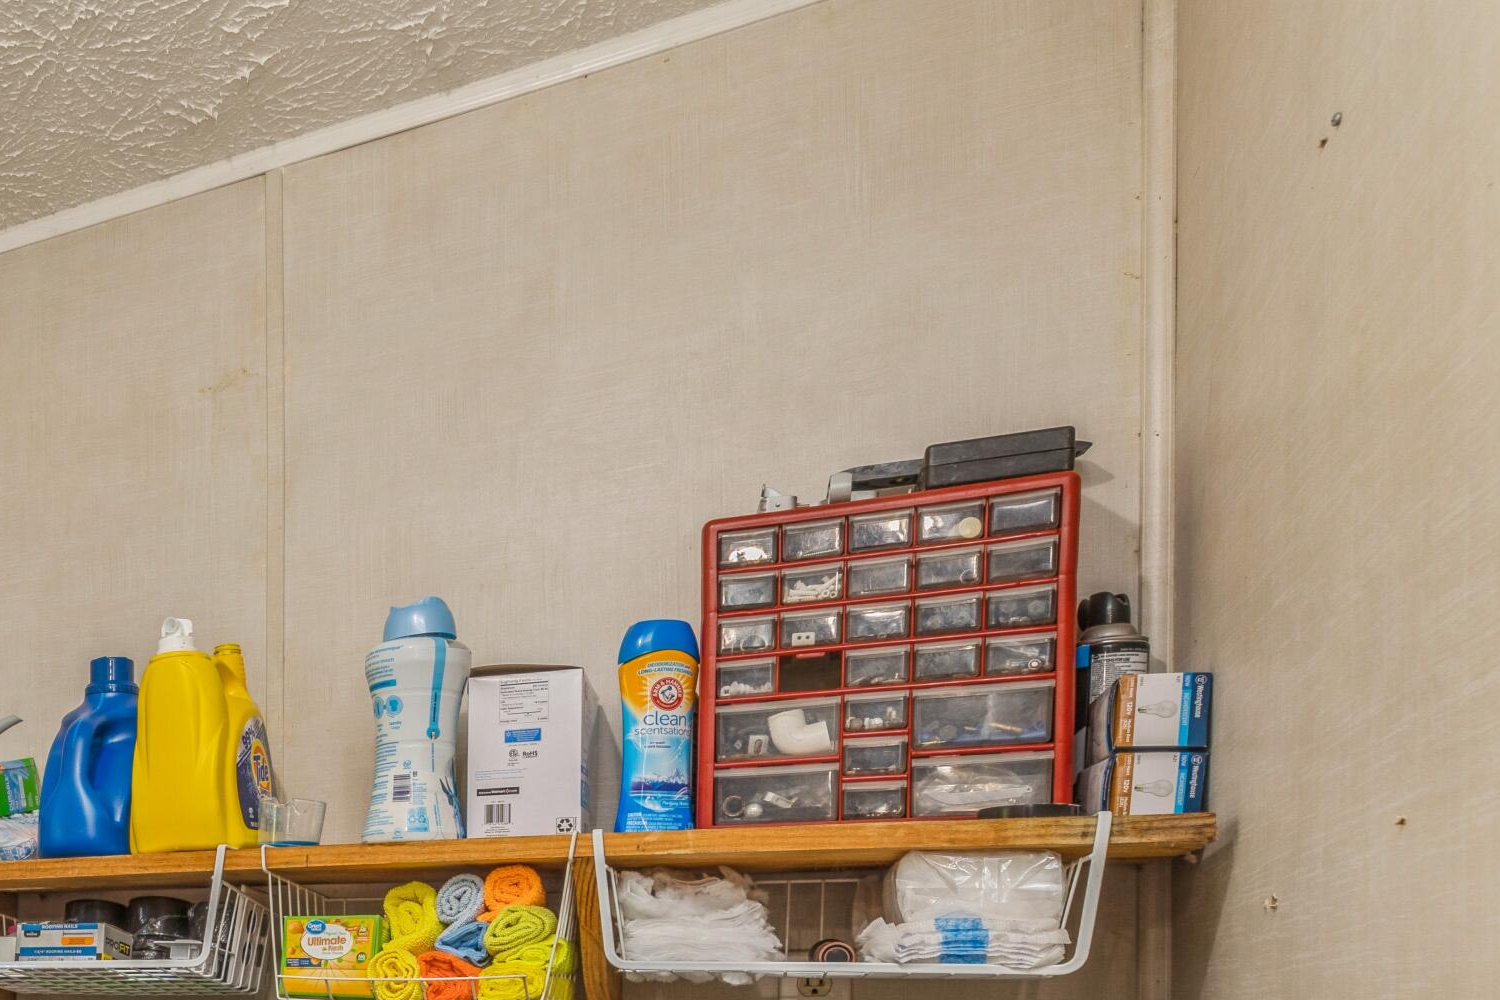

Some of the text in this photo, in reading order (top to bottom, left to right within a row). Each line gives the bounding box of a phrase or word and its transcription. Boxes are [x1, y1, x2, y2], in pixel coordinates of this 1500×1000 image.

[666, 680, 682, 697] HAMMER
[1194, 685, 1204, 718] Westinghouse
[644, 711, 686, 726] clean
[253, 755, 268, 785] Tide
[1189, 766, 1199, 798] Westinghouse
[308, 936, 346, 946] Ultimate
